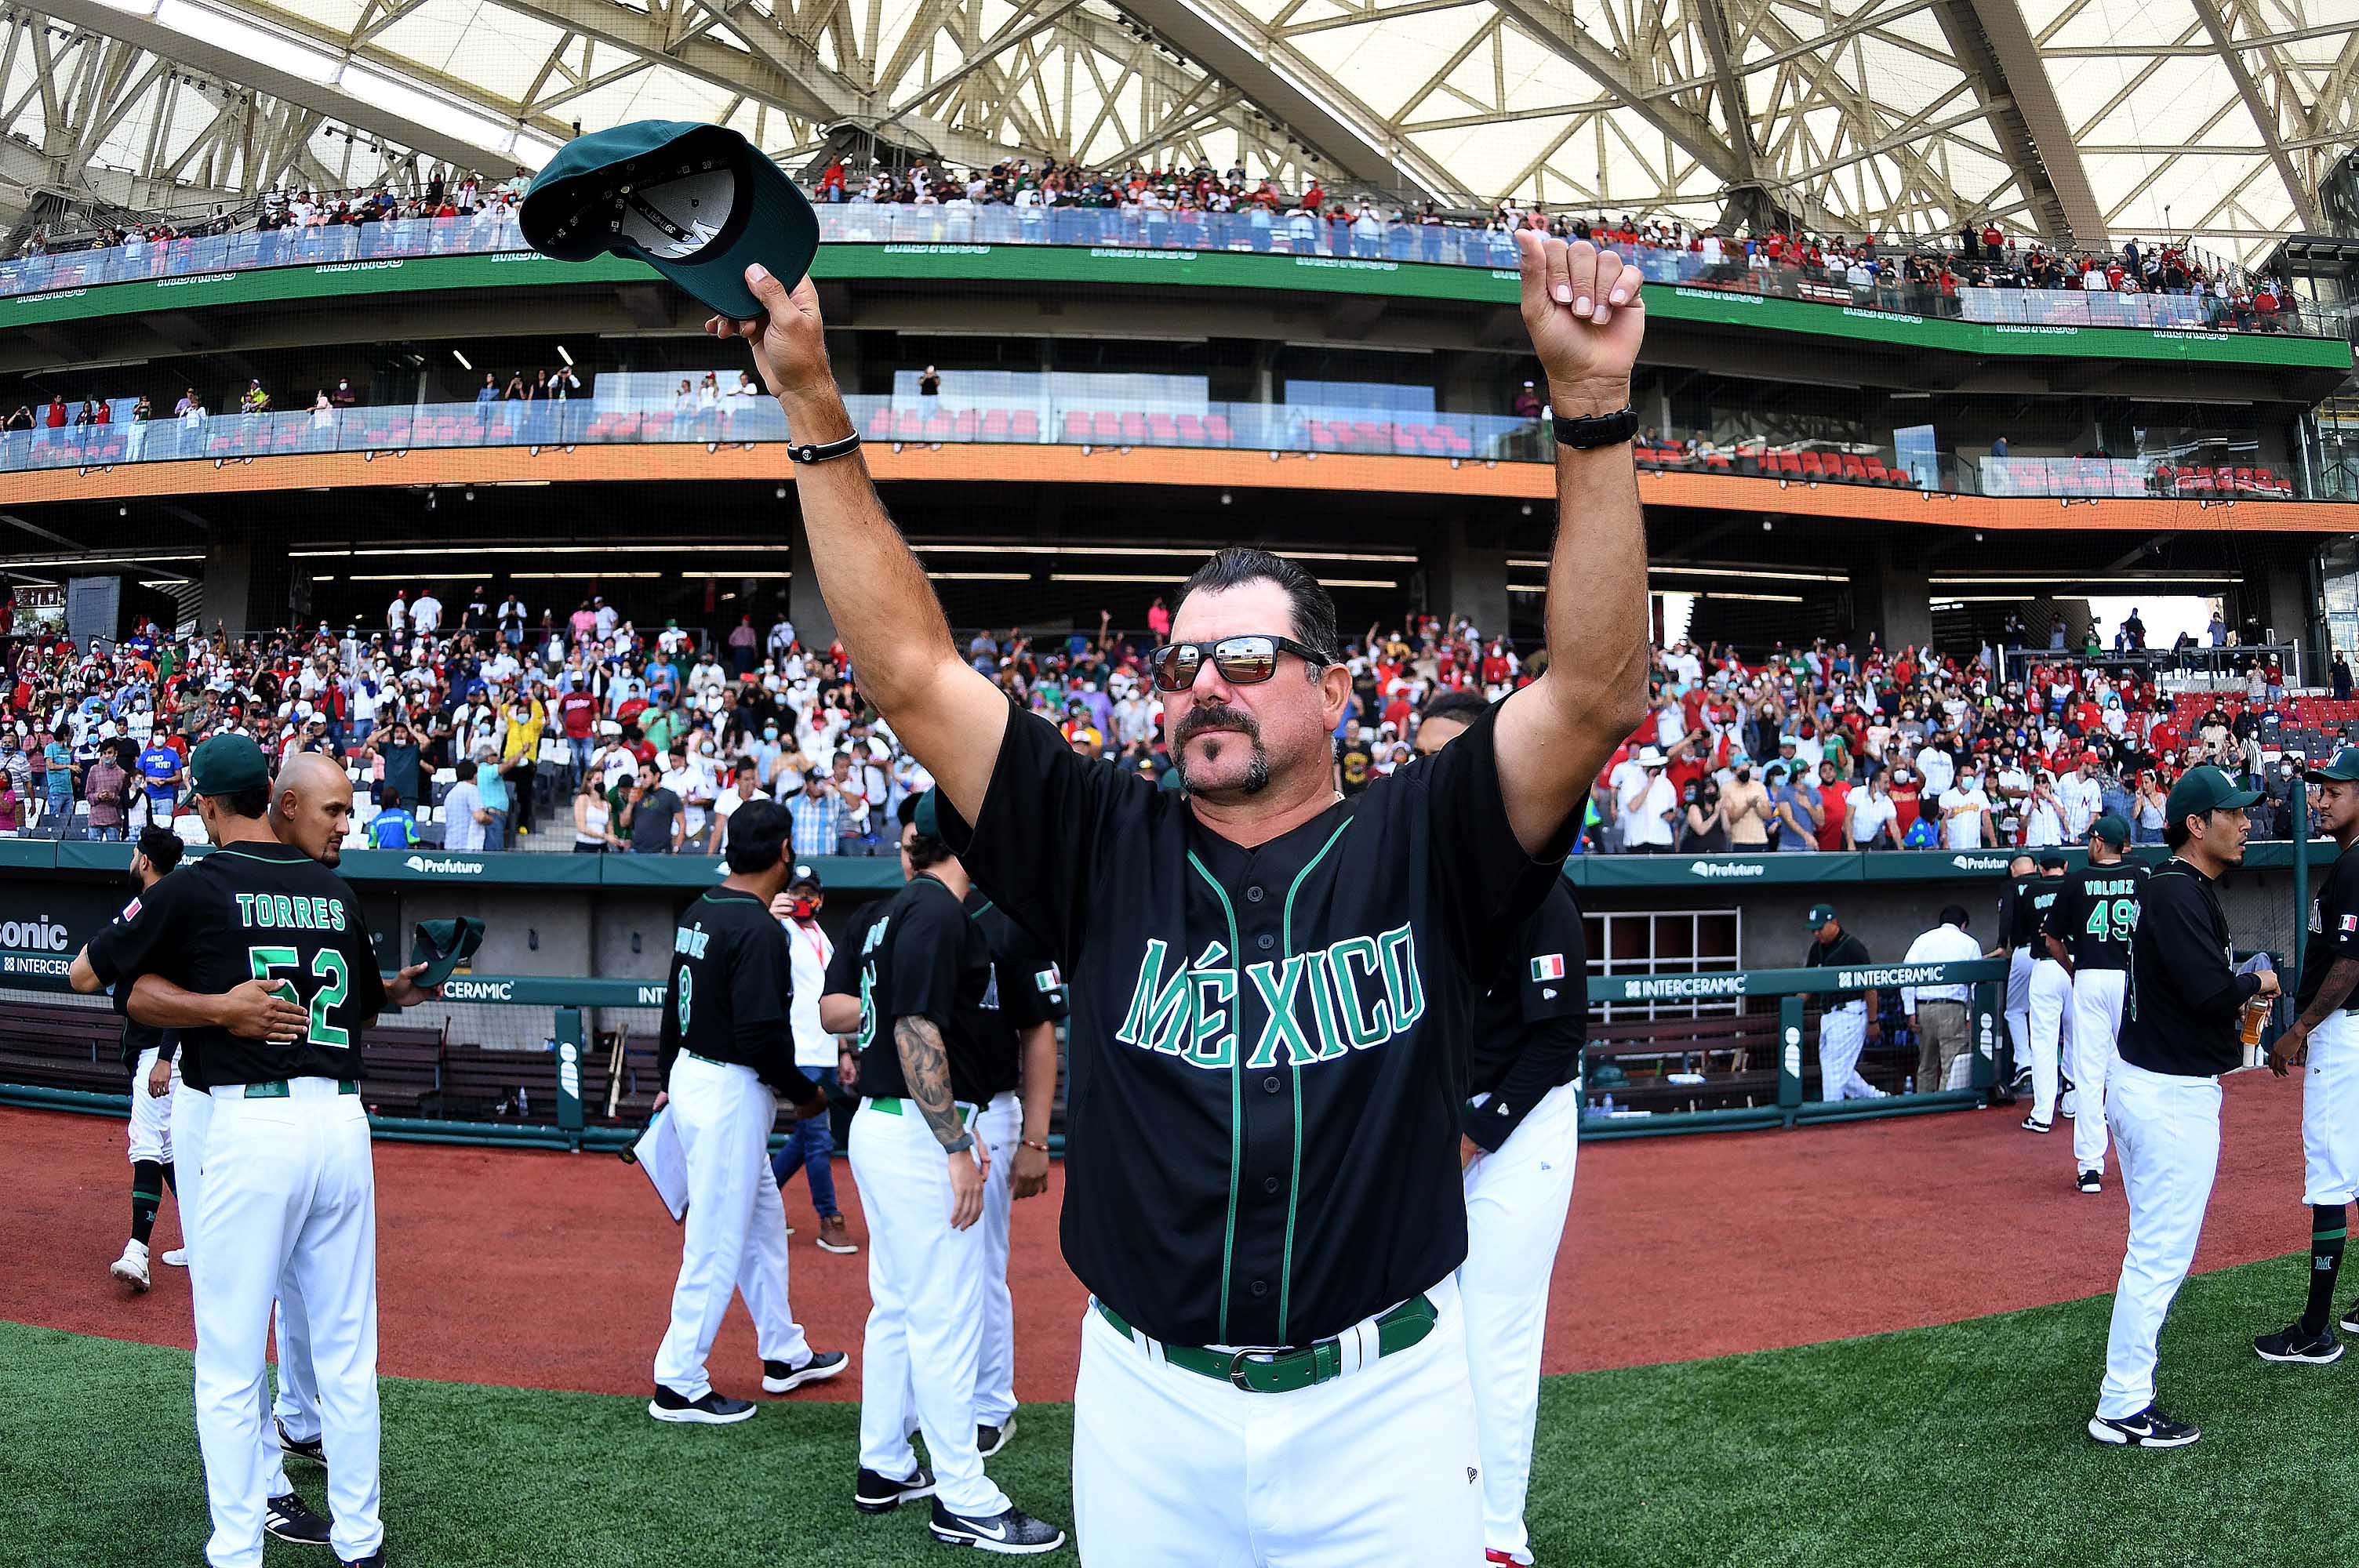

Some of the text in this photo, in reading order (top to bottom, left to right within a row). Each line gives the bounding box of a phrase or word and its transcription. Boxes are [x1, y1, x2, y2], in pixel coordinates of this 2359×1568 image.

[424, 858, 484, 874] Profuturo
[1709, 862, 1764, 877] Profuturo
[1968, 856, 2008, 869] Profutur
[236, 894, 345, 931] TORRES
[2086, 898, 2134, 942] 49
[16, 958, 73, 976] INTERCER
[1854, 966, 1944, 986] INTERCERAMIC
[444, 981, 512, 1000] CERAMIC
[1115, 920, 1426, 1069] MÉXICO
[1643, 977, 1747, 997] INTERCERAMIC
[2314, 1256, 2333, 1270] M
